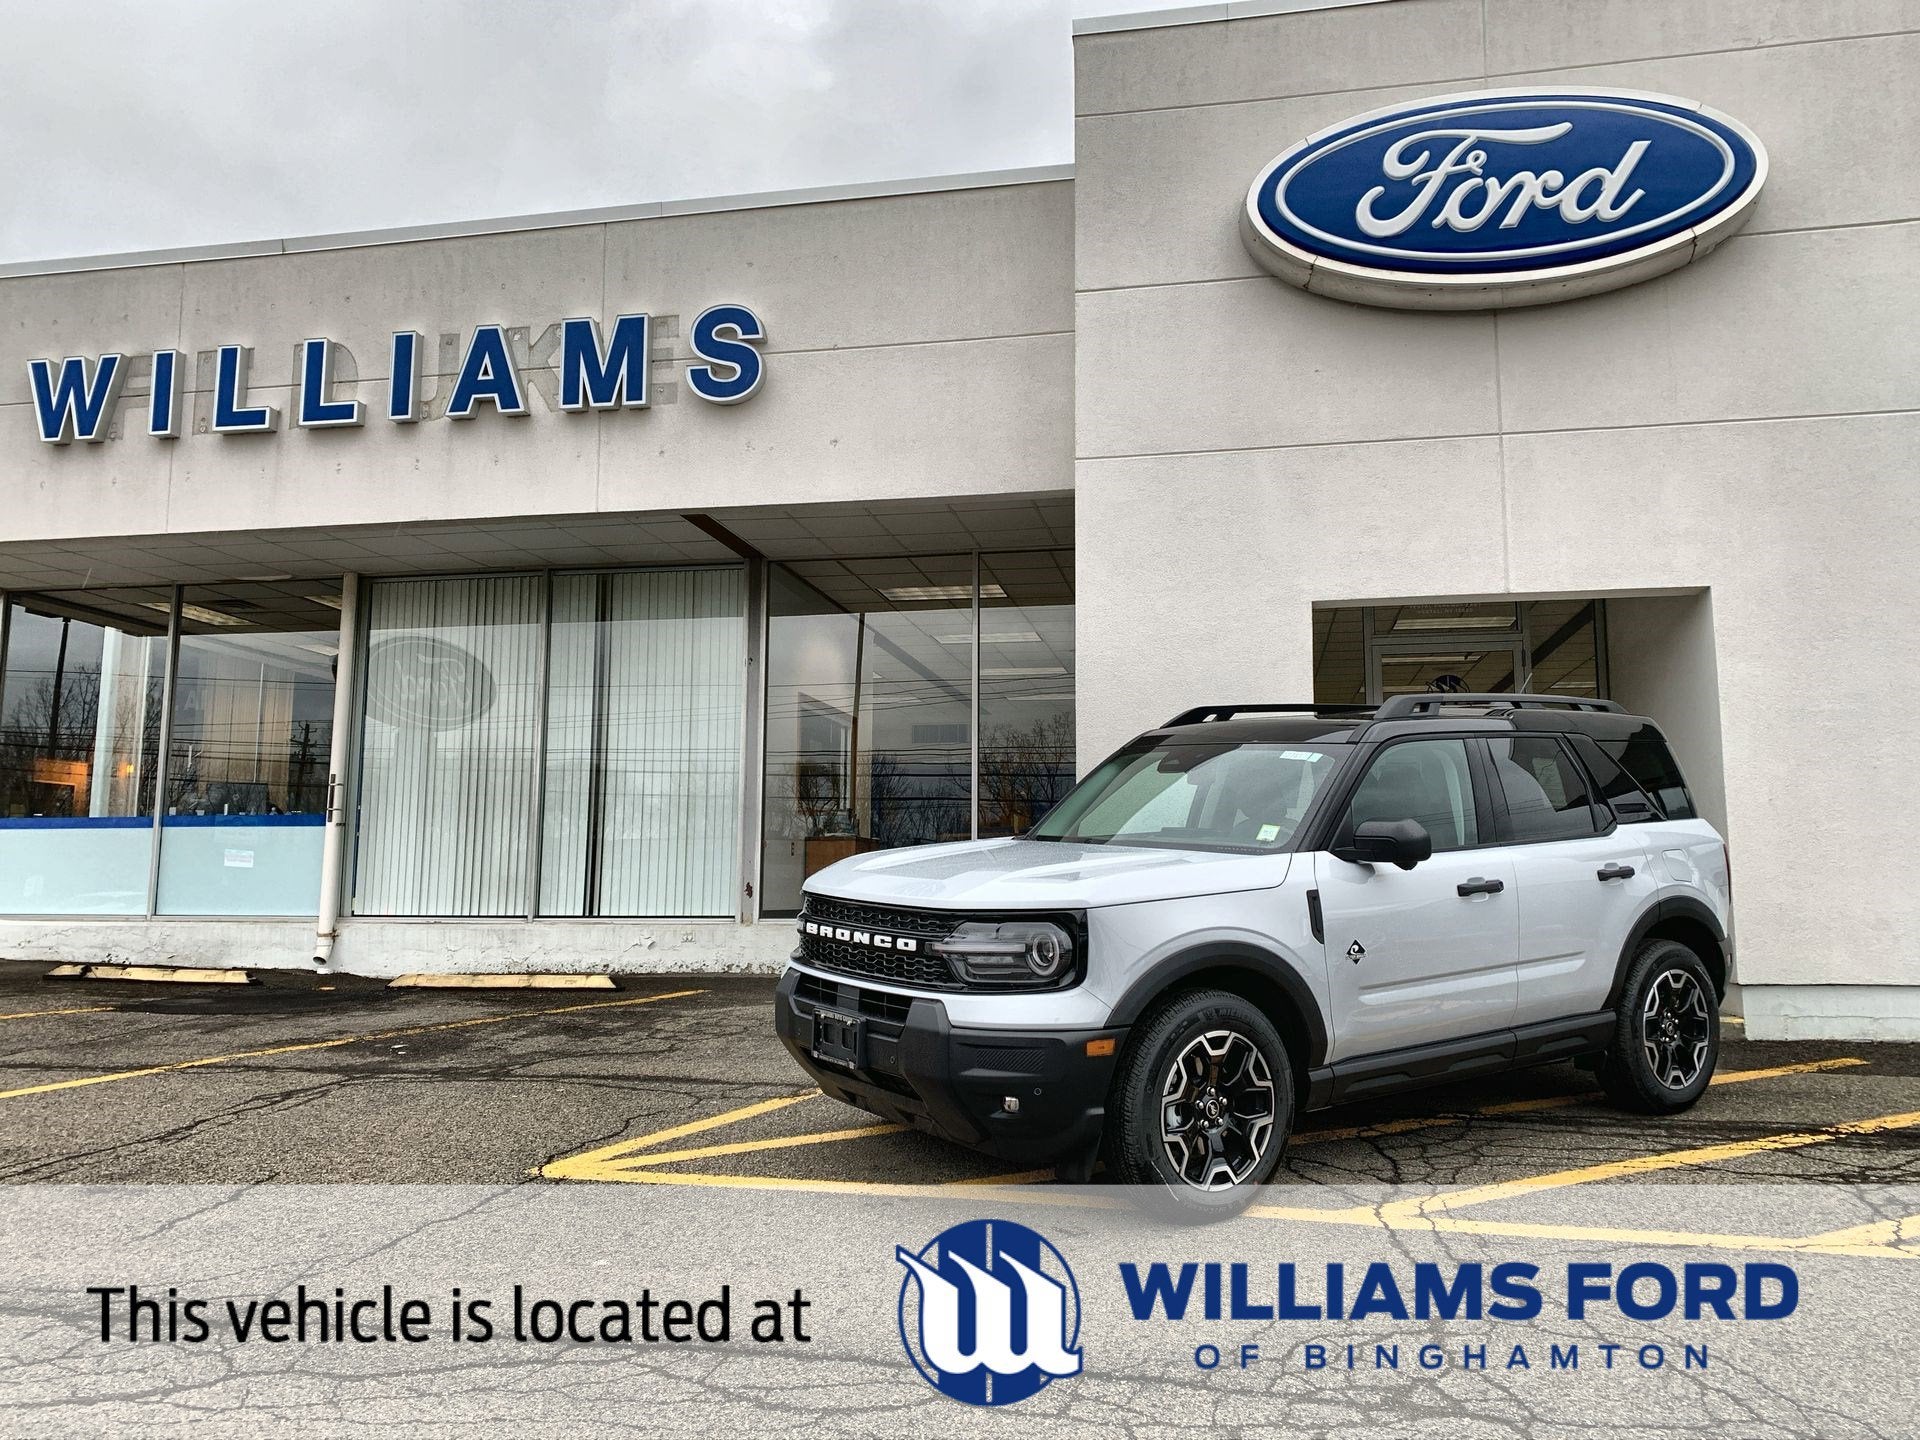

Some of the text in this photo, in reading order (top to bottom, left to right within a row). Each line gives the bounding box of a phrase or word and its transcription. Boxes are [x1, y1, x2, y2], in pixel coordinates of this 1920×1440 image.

[1355, 122, 1652, 238] Ford
[27, 305, 765, 443] WILLIAMS
[806, 922, 917, 952] BRONCO
